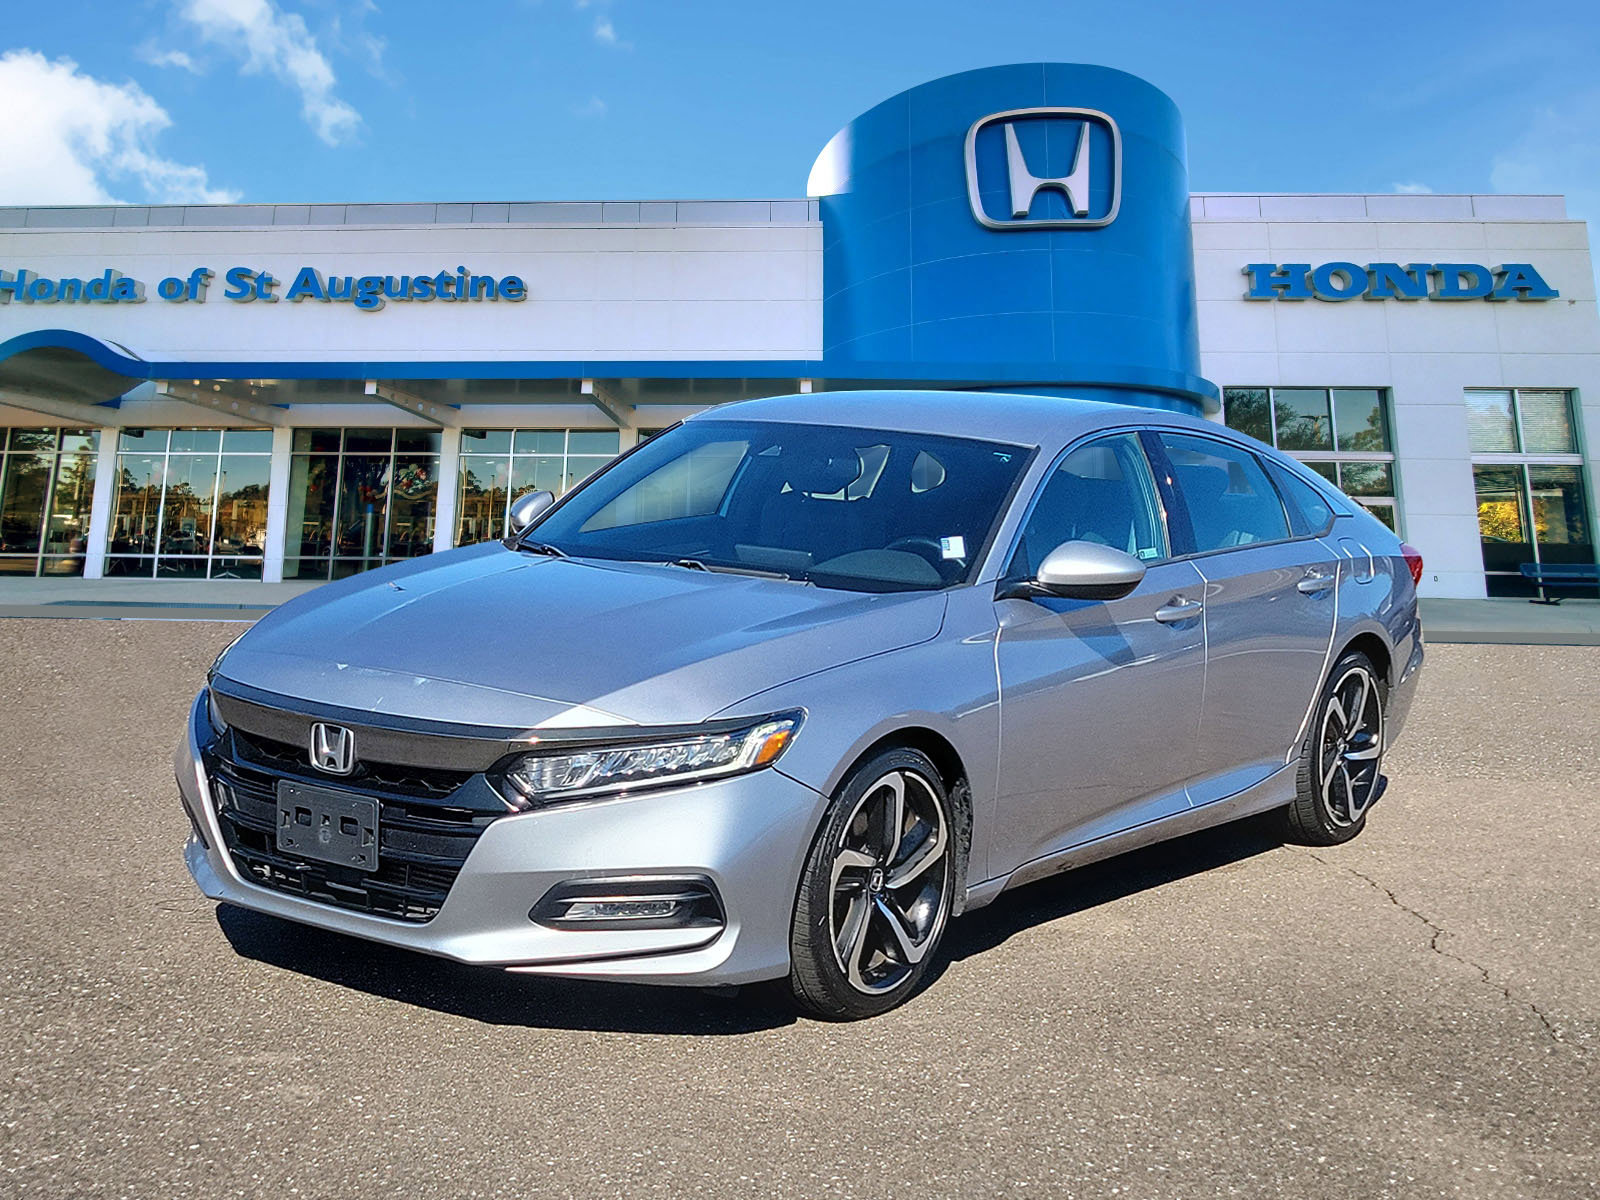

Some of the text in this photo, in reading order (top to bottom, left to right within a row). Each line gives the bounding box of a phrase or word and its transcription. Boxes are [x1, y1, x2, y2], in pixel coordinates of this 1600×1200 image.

[0, 266, 528, 311] Honda of St Augustine
[1242, 261, 1560, 302] HONDA
